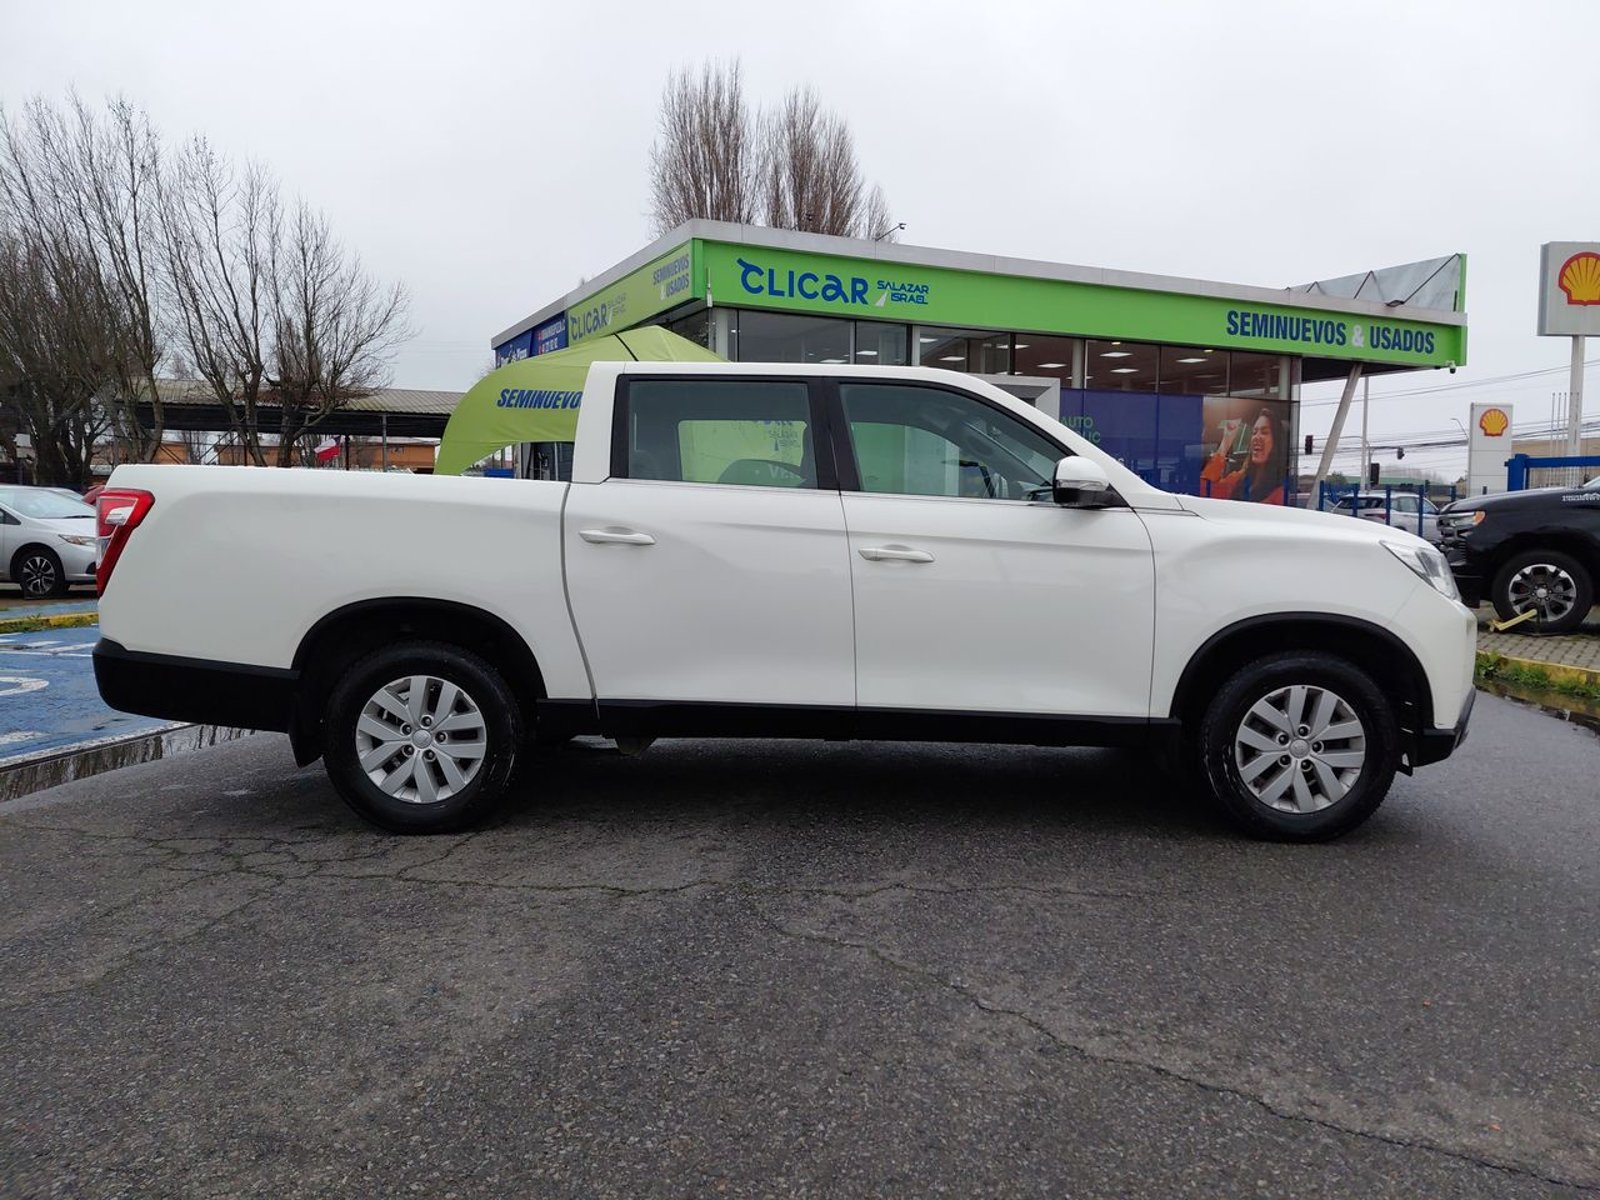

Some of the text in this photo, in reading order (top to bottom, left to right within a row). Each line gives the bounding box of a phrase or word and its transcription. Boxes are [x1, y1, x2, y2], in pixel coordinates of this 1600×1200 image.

[877, 279, 929, 294] SALAZAR
[890, 292, 928, 304] ISRAEL
[1226, 310, 1435, 354] SEMINUEVOS & USADOS
[497, 388, 583, 409] SEMINUEVO
